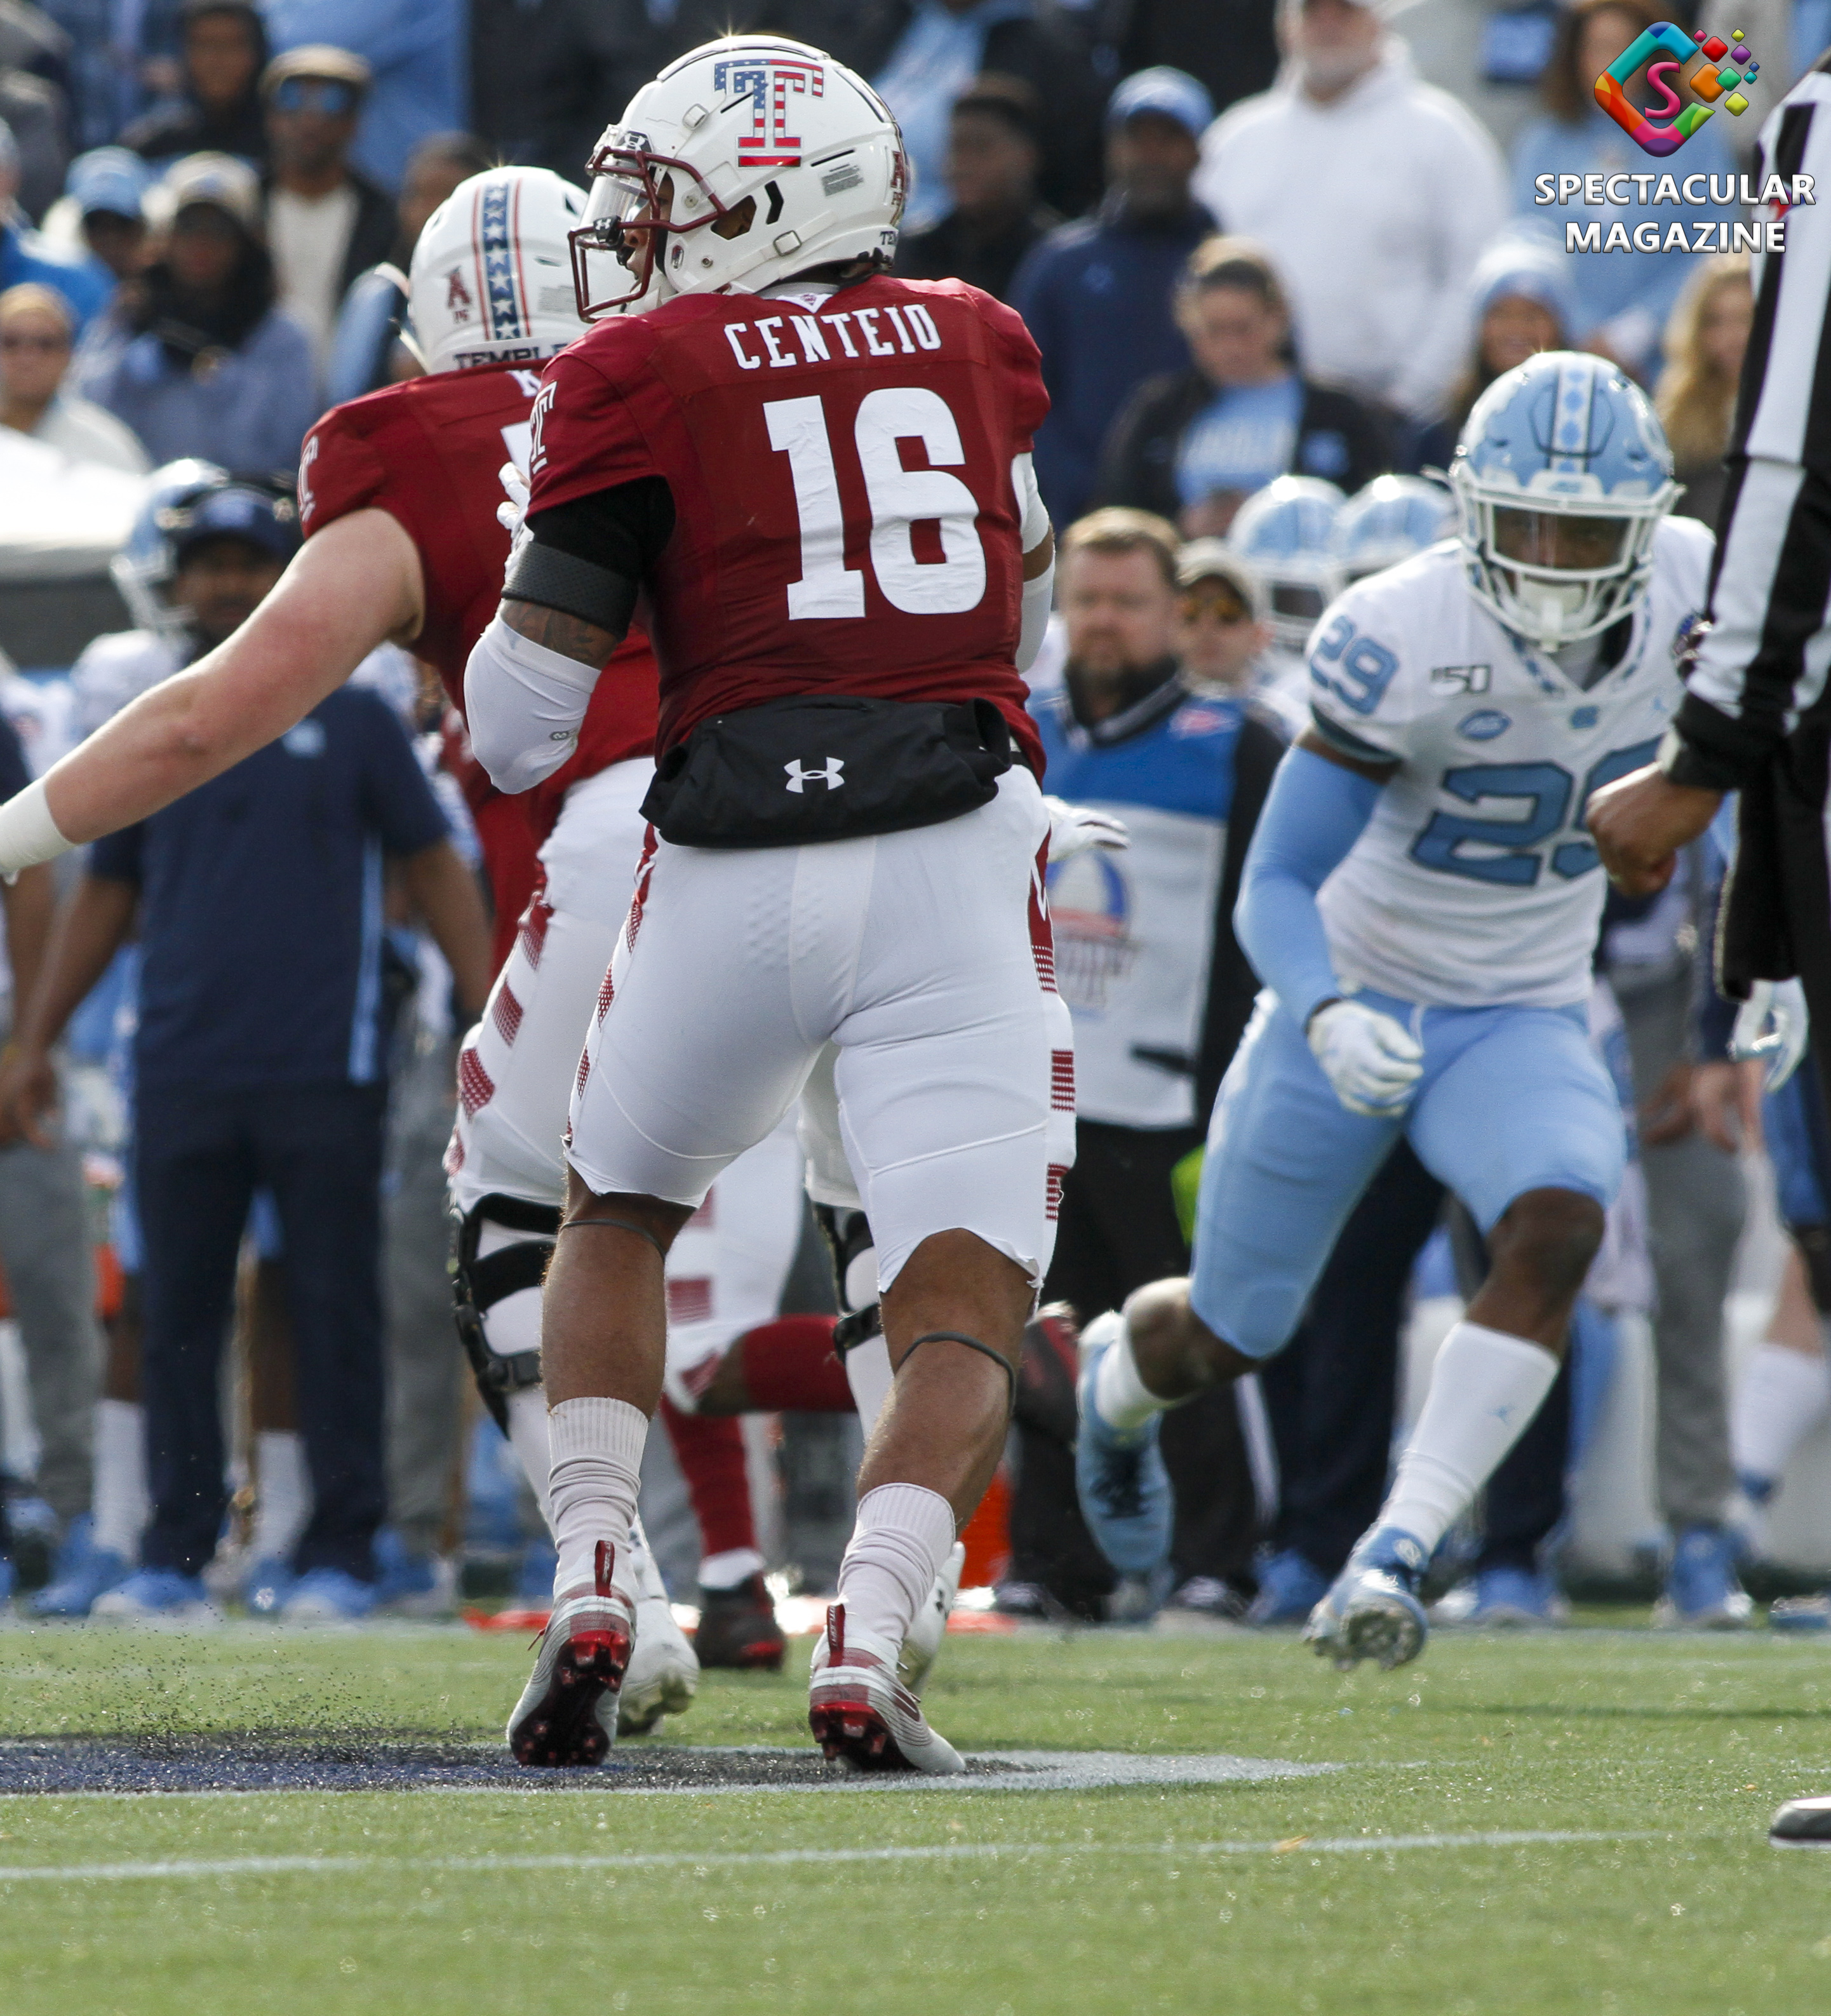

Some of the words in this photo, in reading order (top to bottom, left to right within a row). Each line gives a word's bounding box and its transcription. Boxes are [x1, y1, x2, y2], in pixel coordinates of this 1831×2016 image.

[724, 304, 942, 370] CENTEIO
[762, 387, 987, 621] 16
[1310, 614, 1399, 716] 29
